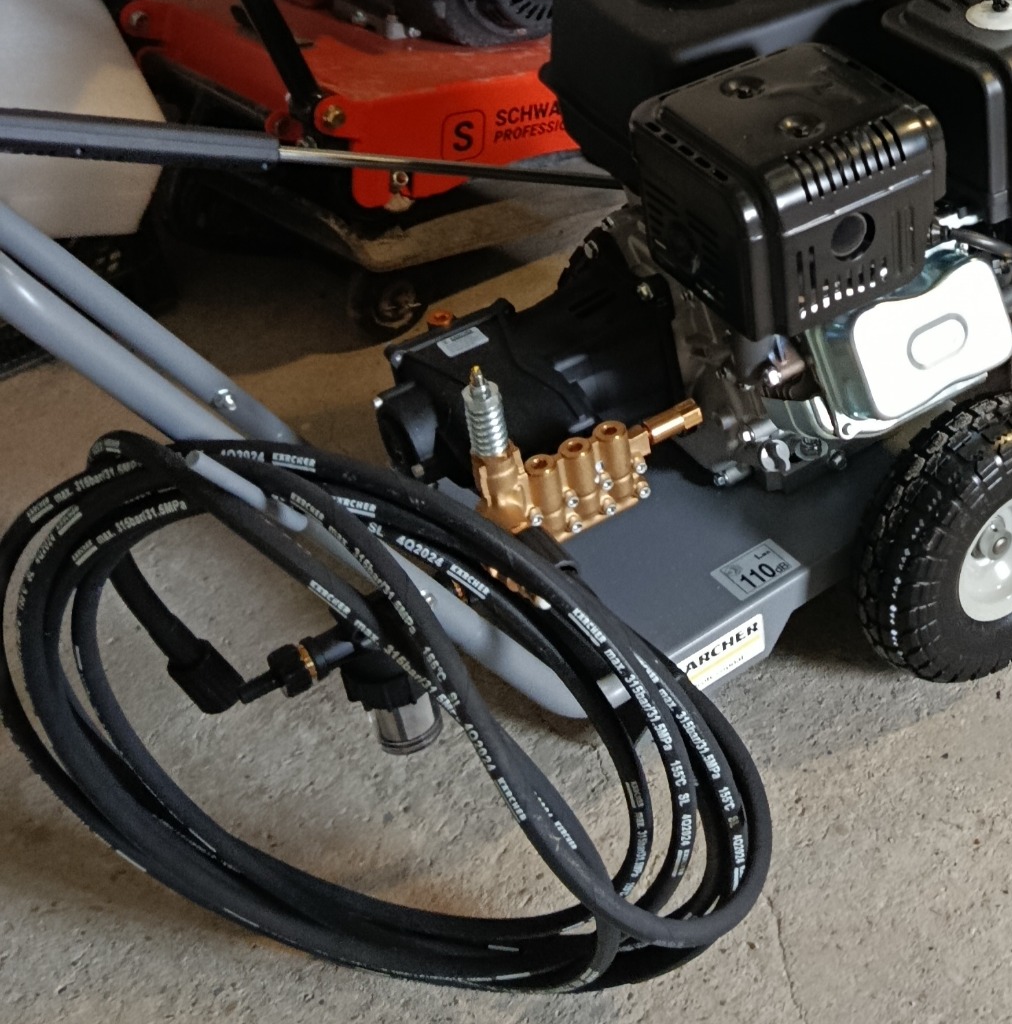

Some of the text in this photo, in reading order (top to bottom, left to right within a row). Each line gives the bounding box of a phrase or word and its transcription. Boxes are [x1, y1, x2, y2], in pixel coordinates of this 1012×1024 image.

[494, 99, 562, 127] SCHWA
[452, 120, 475, 152] S
[332, 495, 378, 513] ÄRCHER
[368, 522, 385, 538] SL
[395, 534, 445, 568] 4Q2024
[604, 648, 626, 675] max.
[625, 673, 673, 752] 315bar/31.5MPa
[658, 687, 675, 712] max.
[675, 711, 721, 781] 315bar/31.5MPa
[732, 833, 746, 865] 4Q2024
[678, 792, 691, 808] SL
[680, 813, 692, 847] 4Q2024
